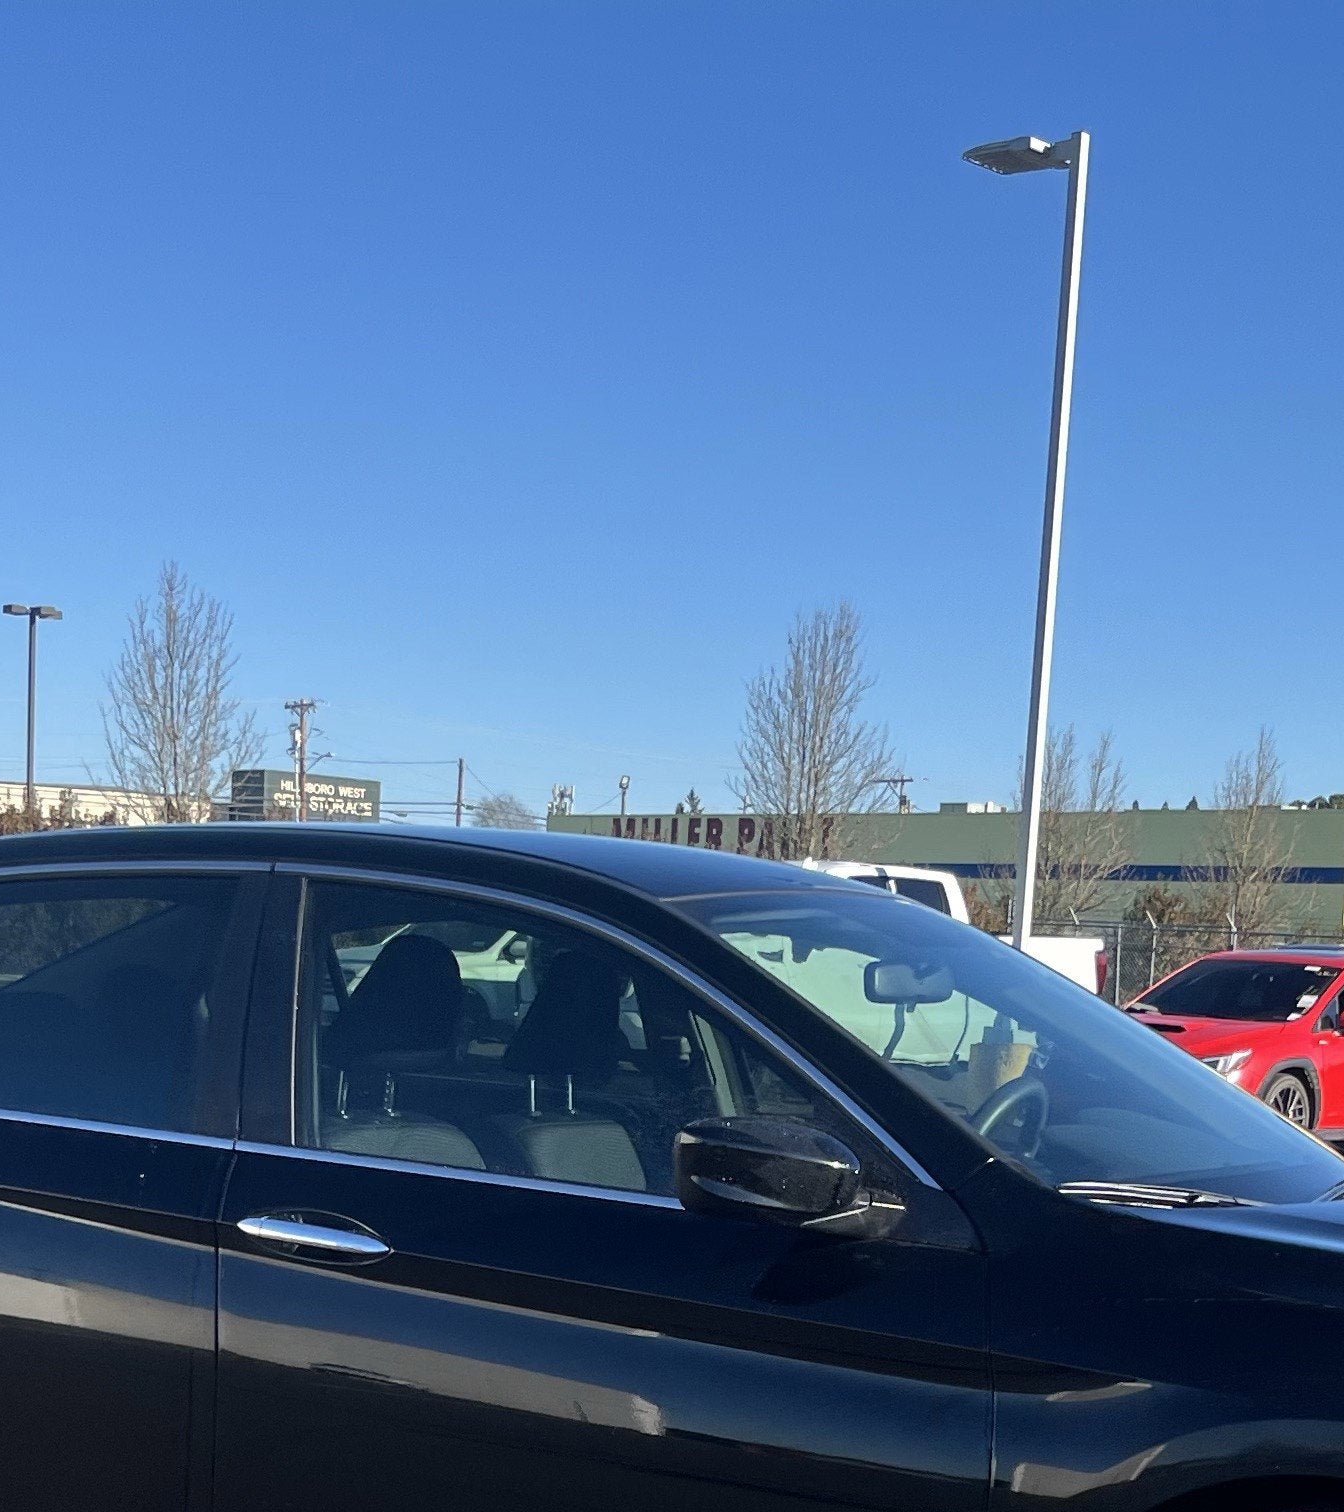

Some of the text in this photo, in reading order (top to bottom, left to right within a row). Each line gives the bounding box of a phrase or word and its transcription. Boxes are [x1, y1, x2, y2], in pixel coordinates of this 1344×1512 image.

[280, 779, 367, 799] HILBORO WEST
[309, 796, 373, 817] STORAGE
